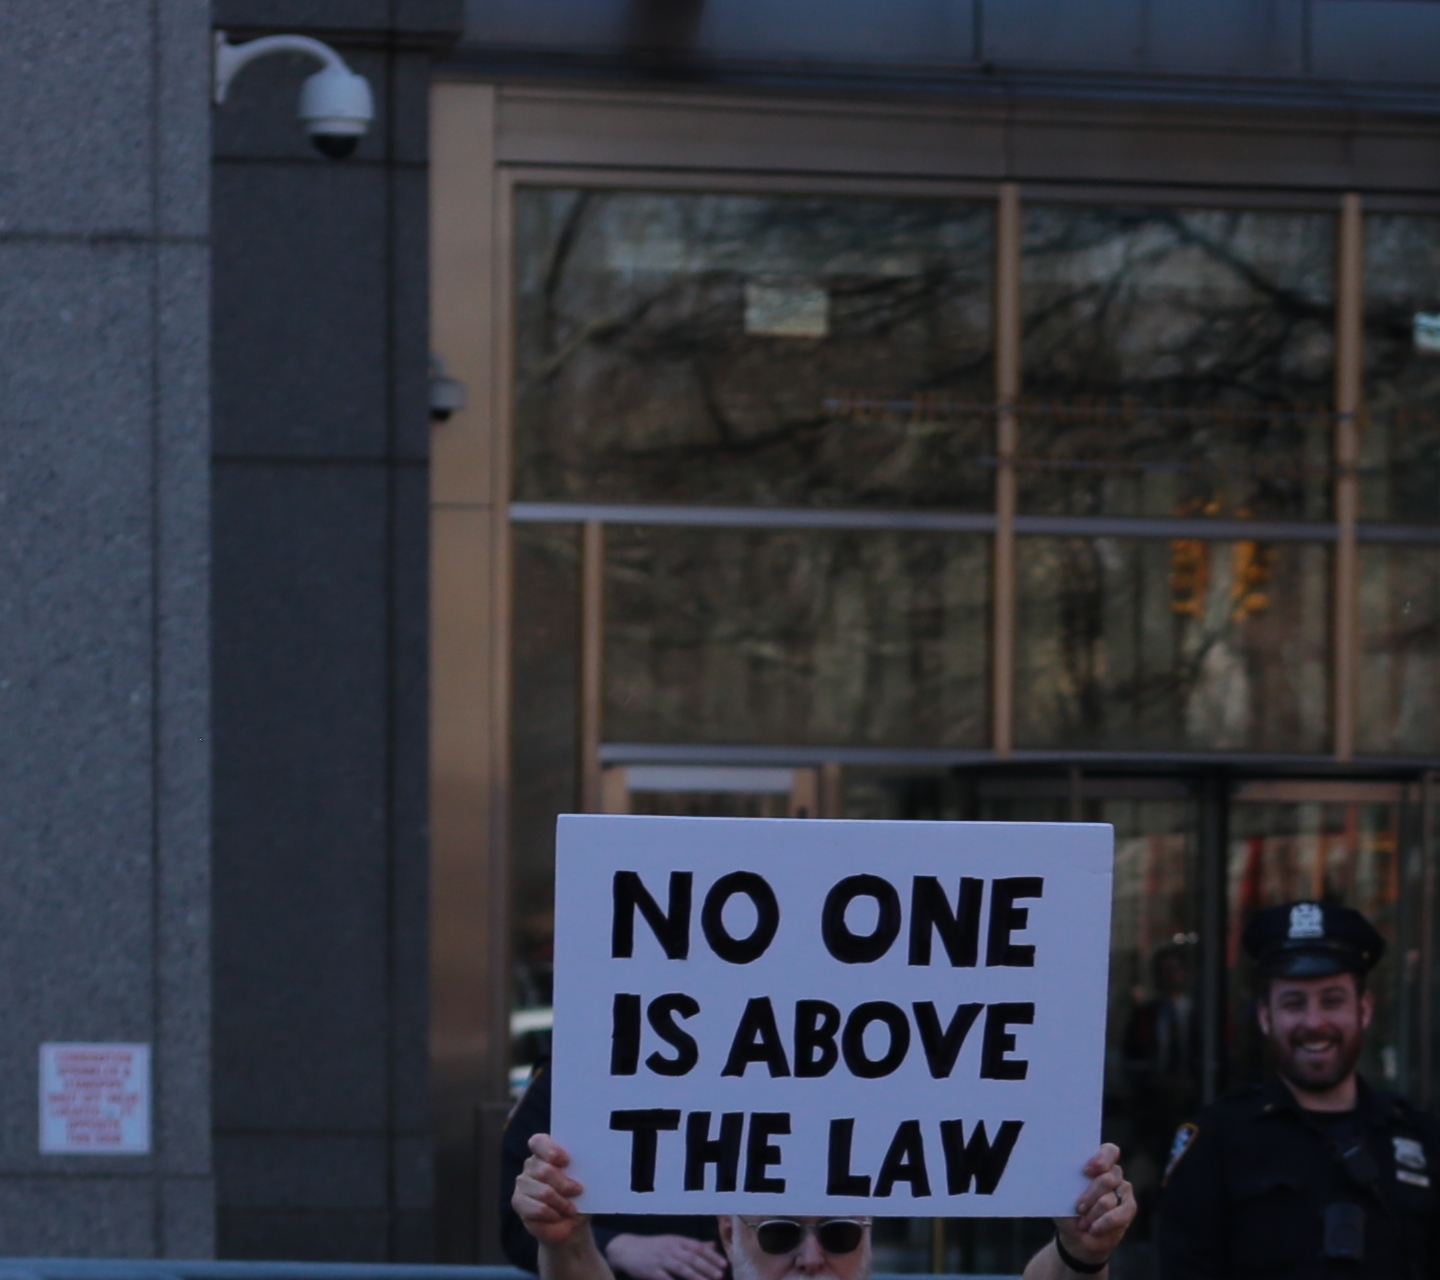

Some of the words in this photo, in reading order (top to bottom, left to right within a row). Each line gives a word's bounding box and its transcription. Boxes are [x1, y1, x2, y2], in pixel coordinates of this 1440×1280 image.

[611, 871, 780, 964] NO
[821, 873, 1044, 968] ONE
[610, 993, 700, 1077] IS
[721, 996, 1035, 1080] ABOVE
[609, 1108, 791, 1193] THE
[826, 1118, 1025, 1197] LAW
